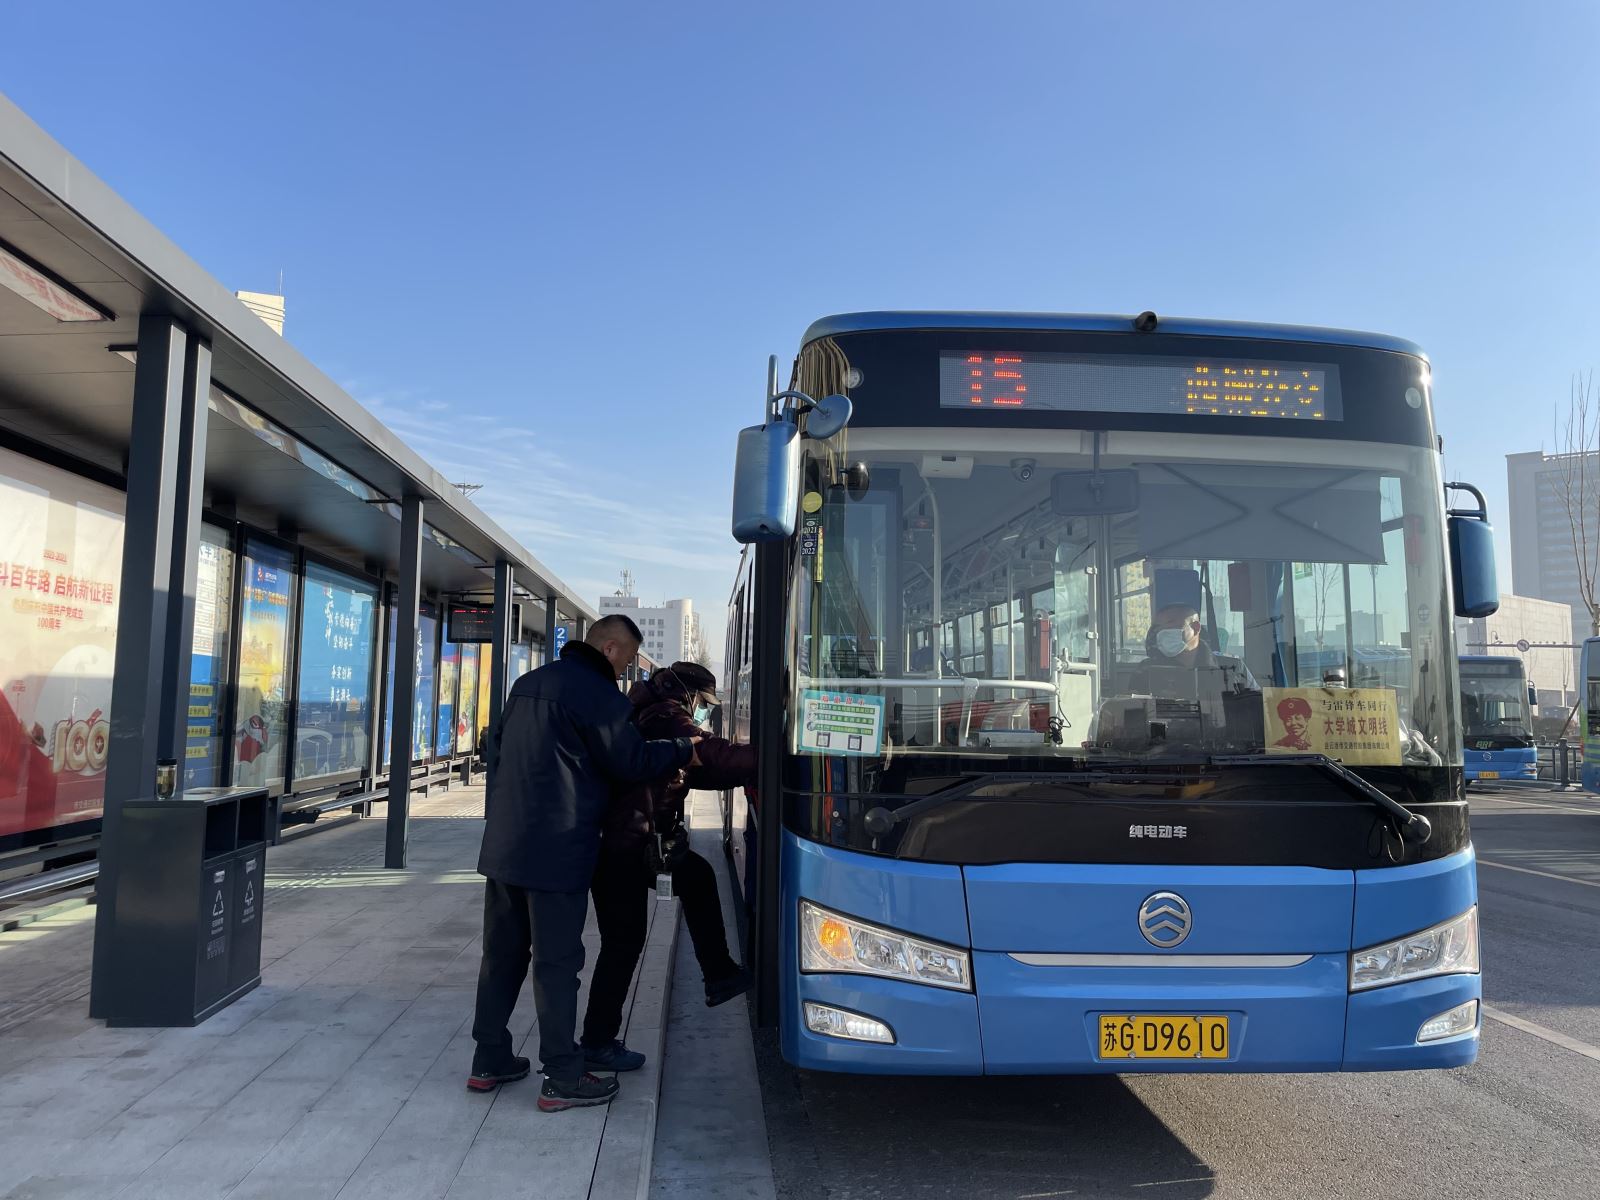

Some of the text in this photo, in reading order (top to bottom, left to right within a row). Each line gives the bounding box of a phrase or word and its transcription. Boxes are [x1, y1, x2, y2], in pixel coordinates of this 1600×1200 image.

[967, 356, 1026, 404] 15
[54, 573, 113, 604] 启航新征程
[557, 628, 565, 638] 2
[1322, 700, 1387, 711] 与雷锋车同行
[1324, 717, 1388, 736] 大学城文明线
[1475, 740, 1494, 748] BRT
[1129, 824, 1187, 838] 纯电动车
